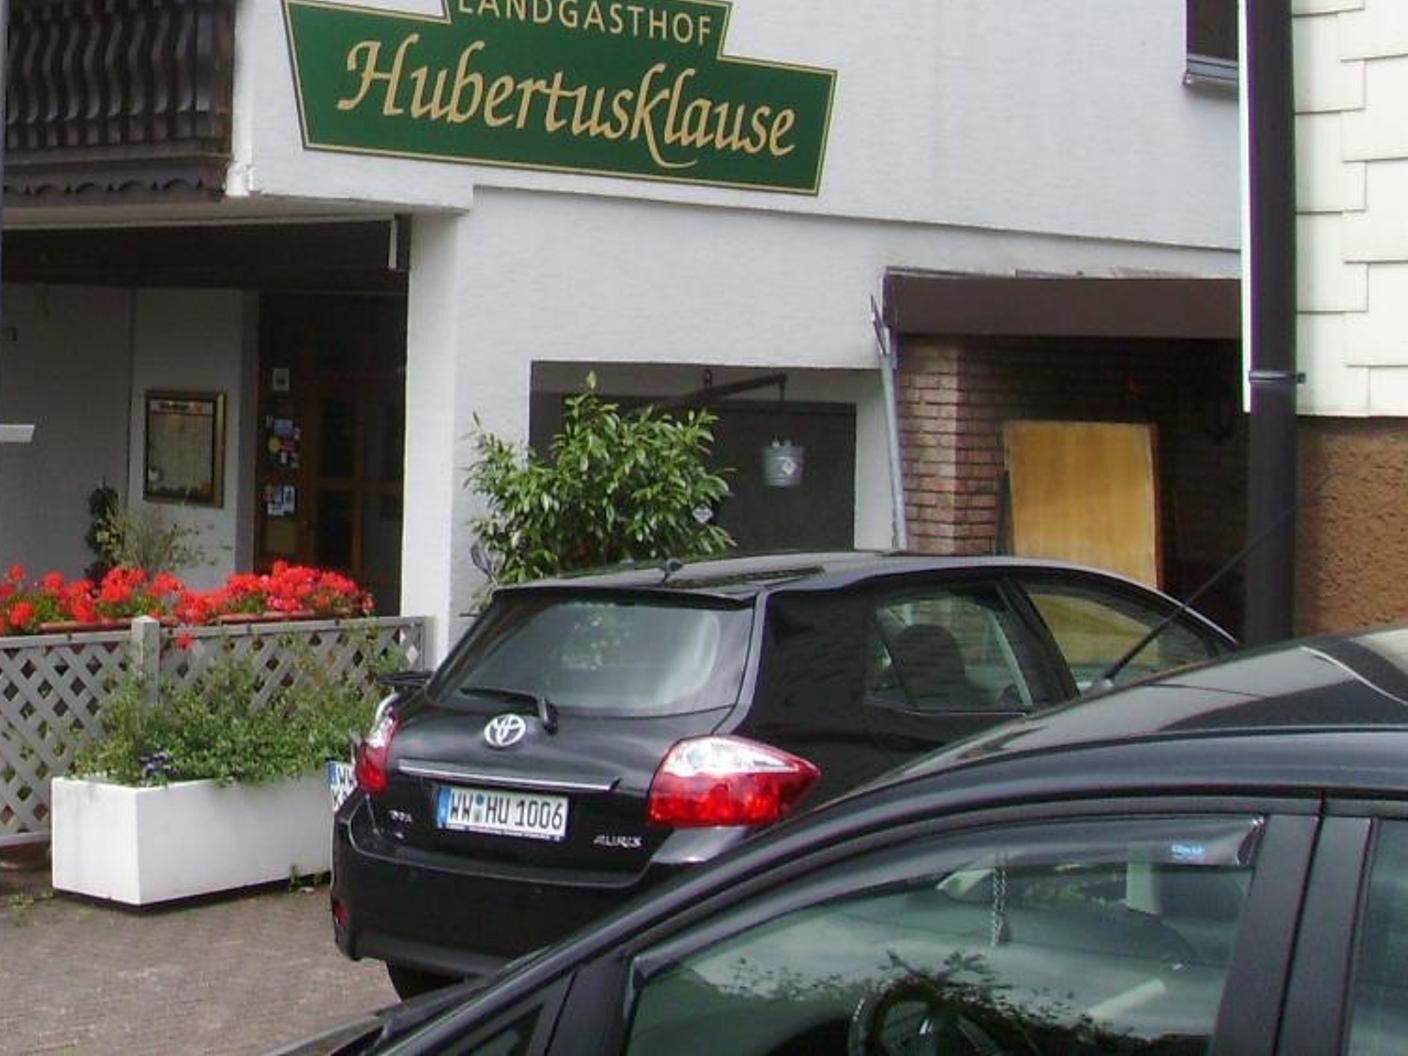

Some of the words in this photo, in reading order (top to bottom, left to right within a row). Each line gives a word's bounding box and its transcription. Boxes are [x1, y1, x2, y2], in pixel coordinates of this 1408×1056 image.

[450, 790, 473, 822] WW
[485, 795, 510, 825] HU
[514, 799, 564, 830] 1006
